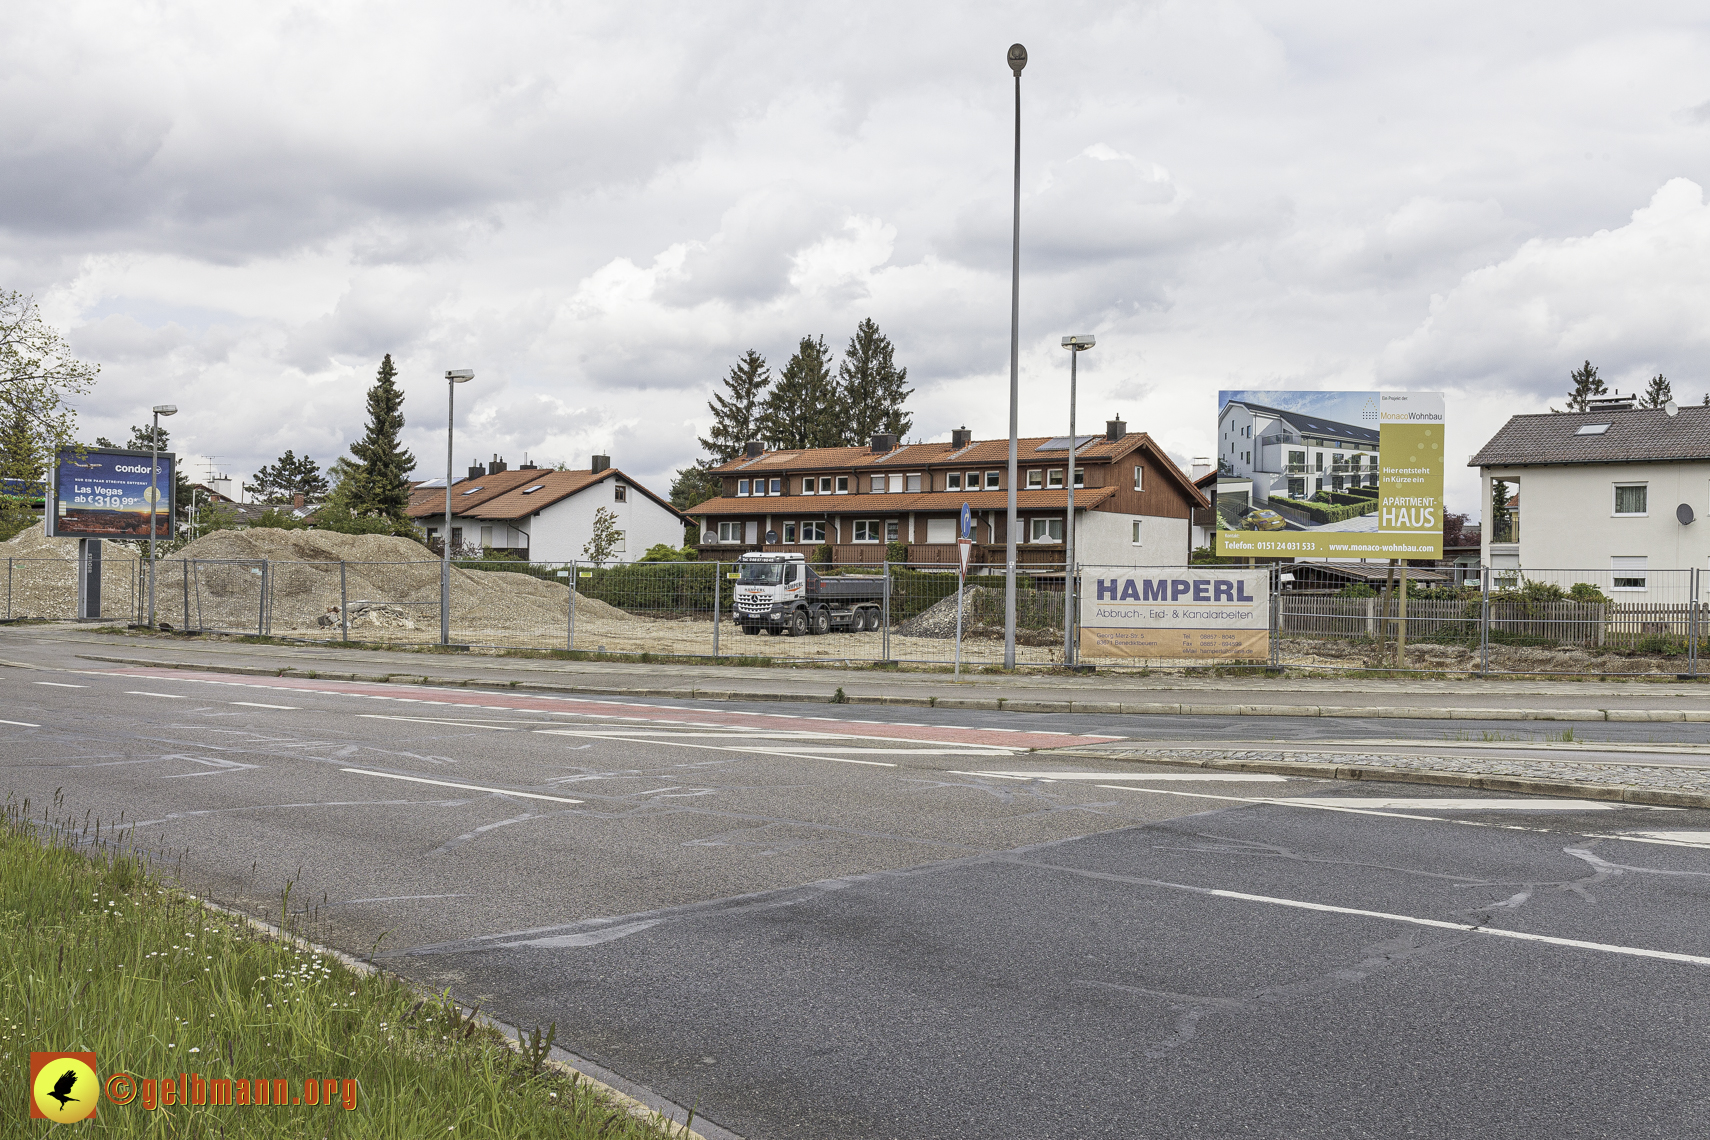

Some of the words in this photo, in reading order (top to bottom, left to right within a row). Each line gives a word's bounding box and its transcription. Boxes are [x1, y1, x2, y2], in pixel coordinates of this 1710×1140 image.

[1381, 412, 1442, 420] MonacoWohnbau
[115, 465, 152, 474] condor
[74, 485, 91, 494] Las
[94, 486, 123, 496] Vegas
[1382, 497, 1437, 506] APARTMENT-
[1382, 508, 1434, 527] HAUS
[1225, 541, 1254, 550] Telefon:
[1329, 544, 1434, 552] www.monaco-wohnbau.com
[1096, 578, 1254, 602] HAMPERL
[1096, 608, 1146, 618] Abbruch-,
[1150, 610, 1168, 618] Erd-
[1172, 610, 1179, 618] &
[1182, 610, 1253, 620] Kanalarbeiten
